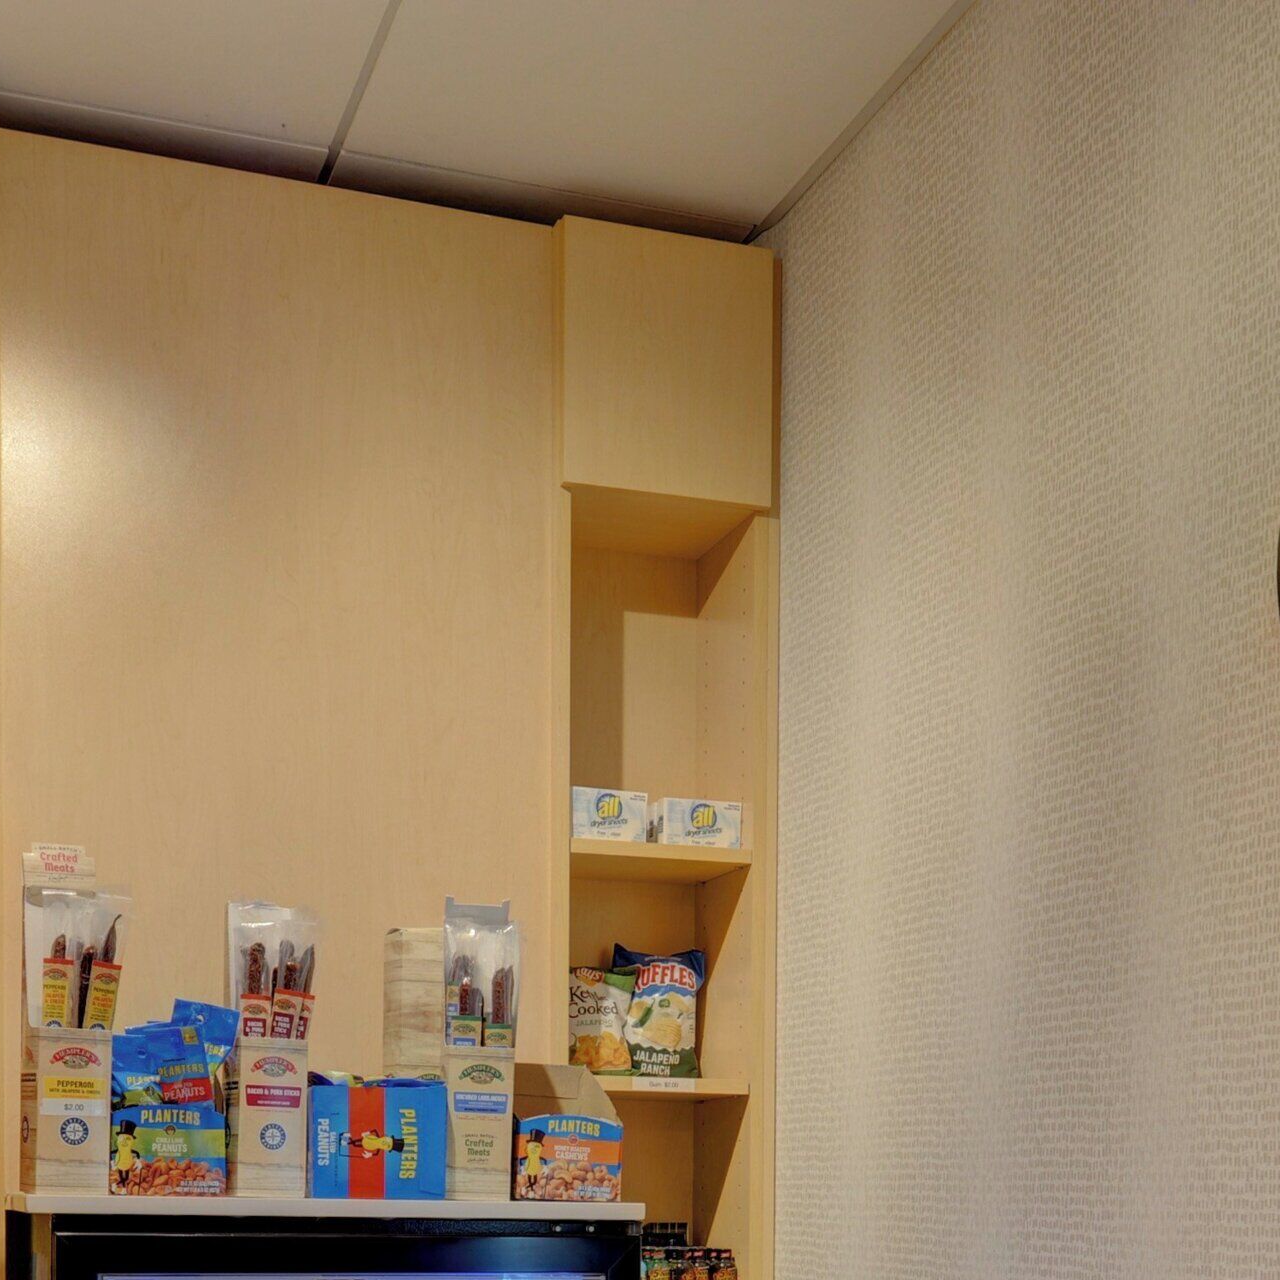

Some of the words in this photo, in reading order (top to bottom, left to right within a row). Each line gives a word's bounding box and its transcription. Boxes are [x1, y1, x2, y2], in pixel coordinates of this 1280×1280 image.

[598, 796, 620, 817] all
[693, 805, 715, 828] all
[40, 852, 78, 864] Crafted
[44, 863, 76, 874] Meats
[569, 1002, 619, 1018] Cooked
[633, 1049, 681, 1065] JALAPEÑO
[158, 1062, 205, 1078] PLANTERS
[640, 1063, 670, 1077] RANCH
[56, 1080, 95, 1089] PEPPERONI
[163, 1086, 206, 1102] PEANUTS
[64, 1103, 84, 1112] $2.00
[140, 1109, 201, 1127] PLANTERS
[548, 1119, 600, 1136] PLANTERS
[151, 1142, 188, 1154] PEANUTS
[317, 1118, 329, 1167] PEANUTS
[398, 1108, 417, 1180] PLANTERS
[465, 1138, 493, 1148] Crafted
[467, 1147, 491, 1157] Meats
[555, 1151, 588, 1161] CASHEWS
